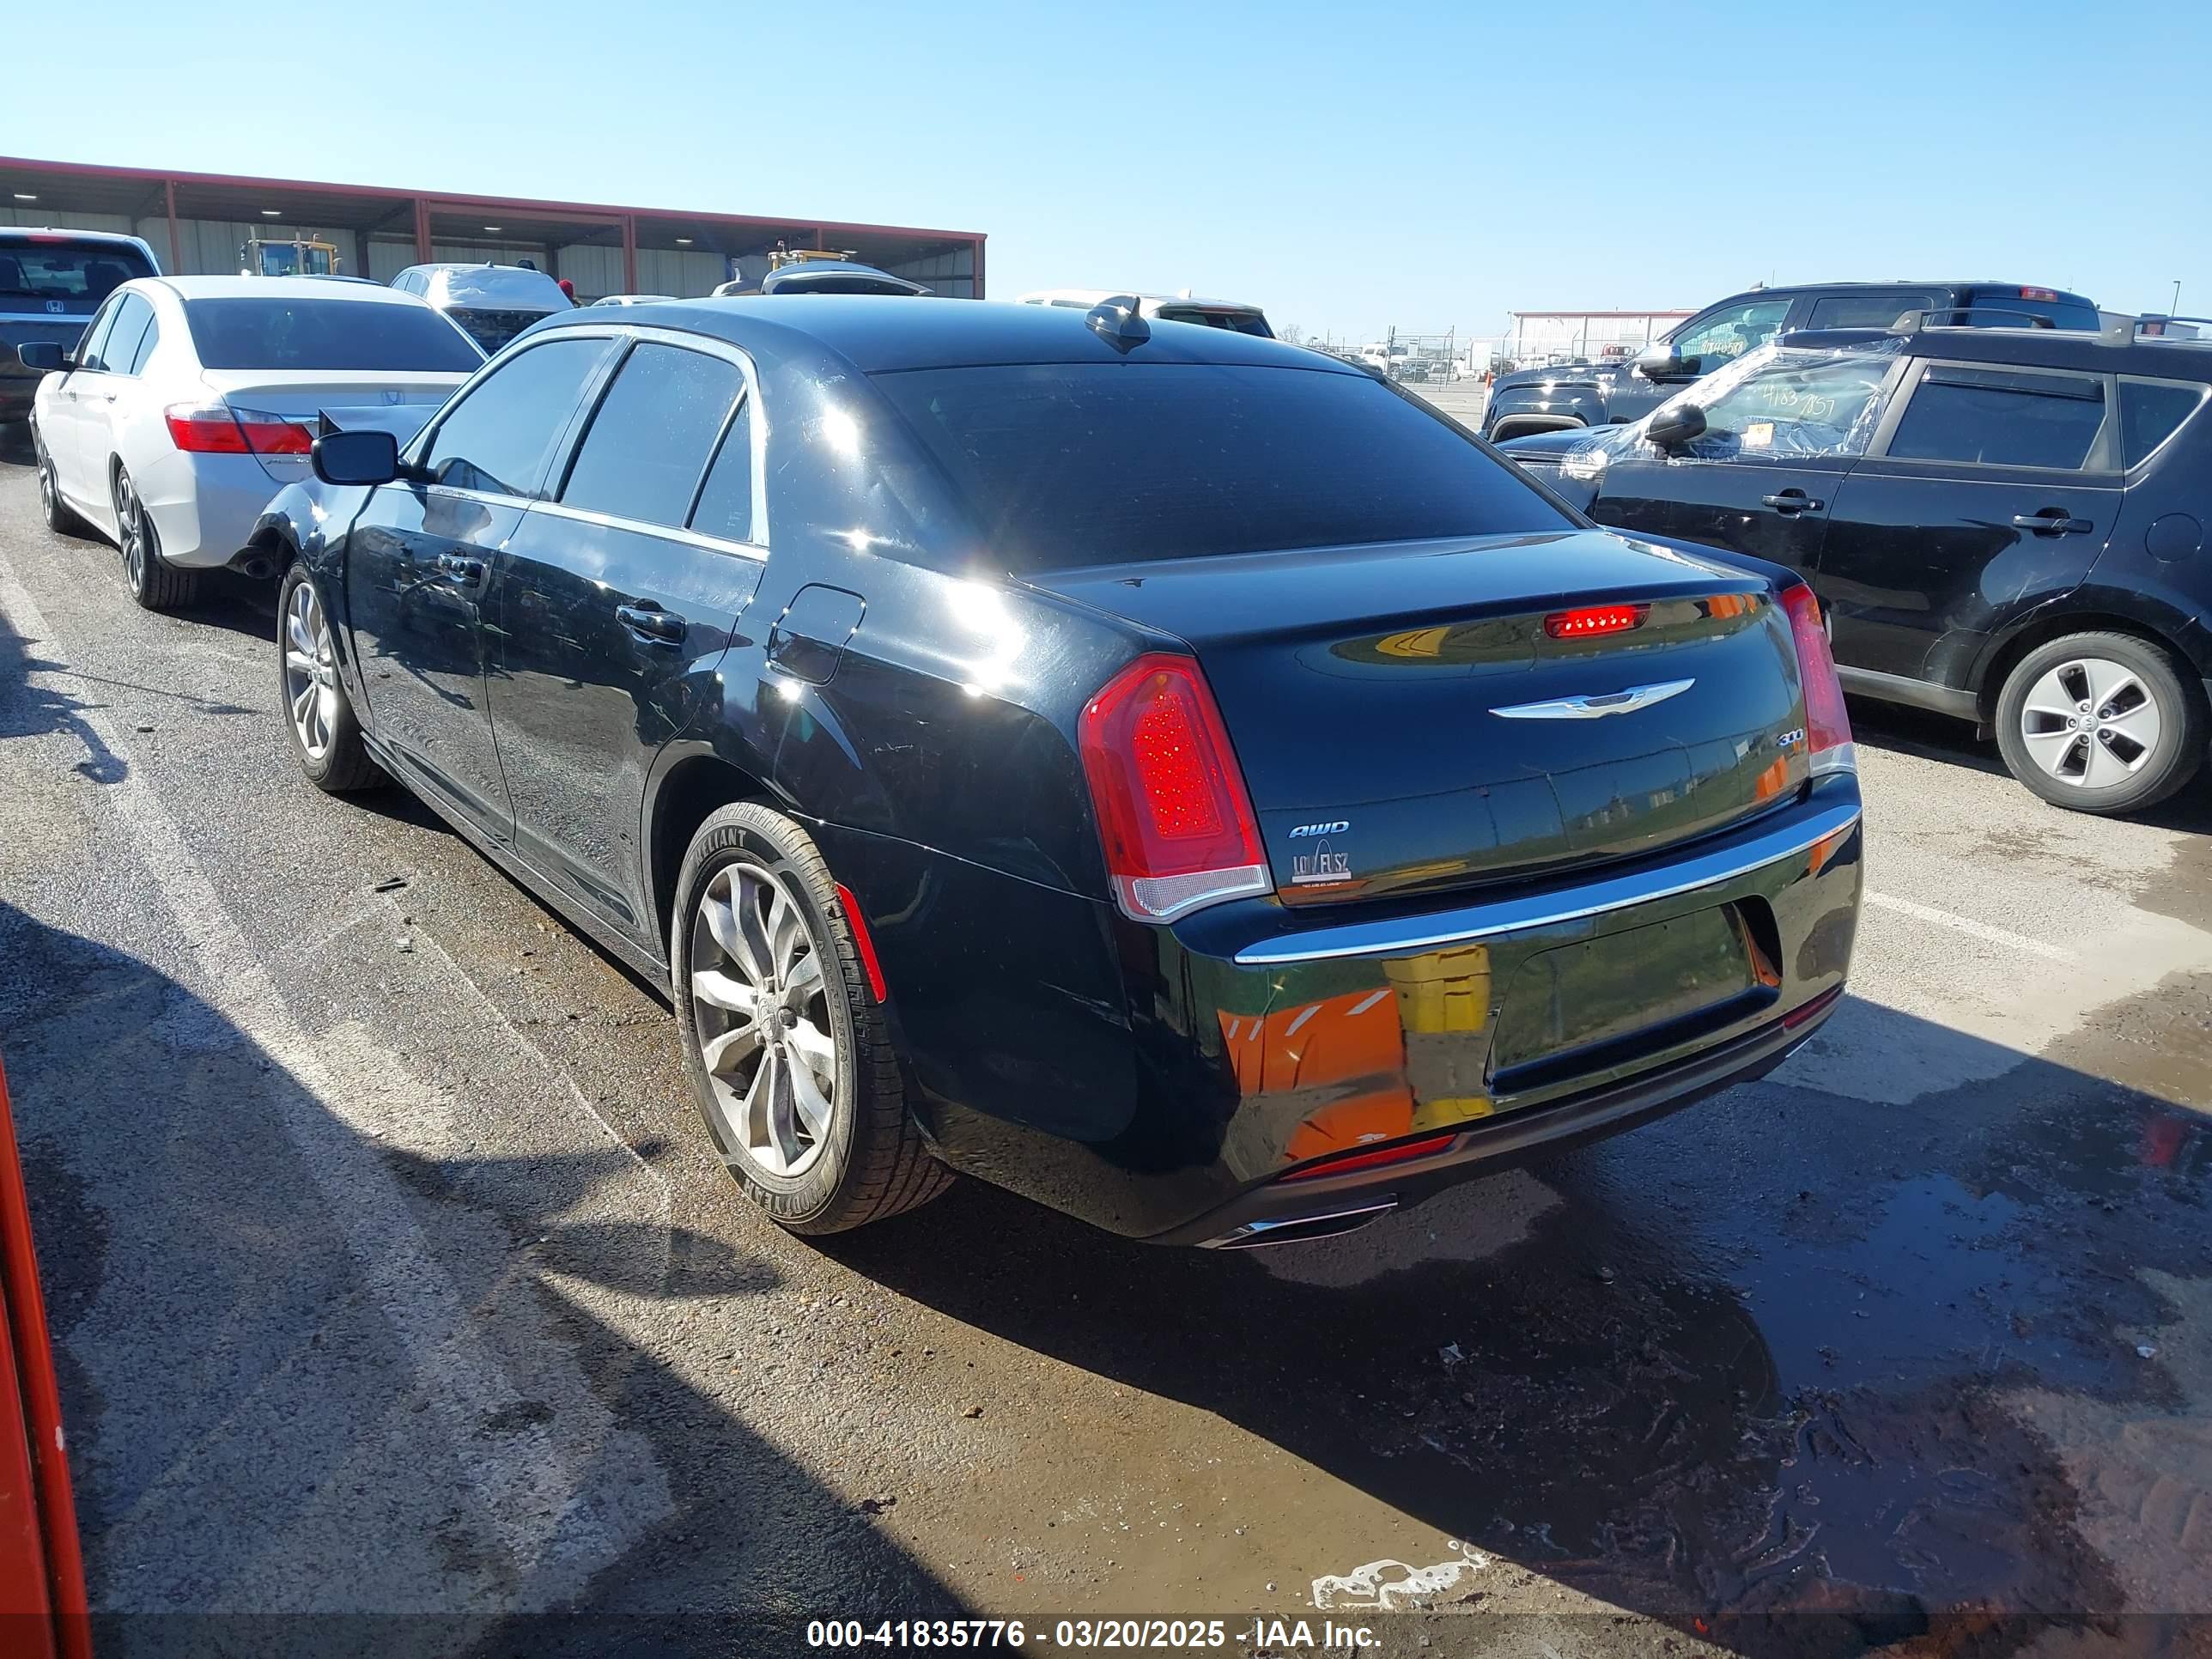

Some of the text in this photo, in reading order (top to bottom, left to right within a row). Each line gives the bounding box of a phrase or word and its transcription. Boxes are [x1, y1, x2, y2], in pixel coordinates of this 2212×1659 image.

[1778, 728, 1803, 746] 300
[1288, 820, 1350, 839] AWD
[694, 828, 746, 866] RELIANT
